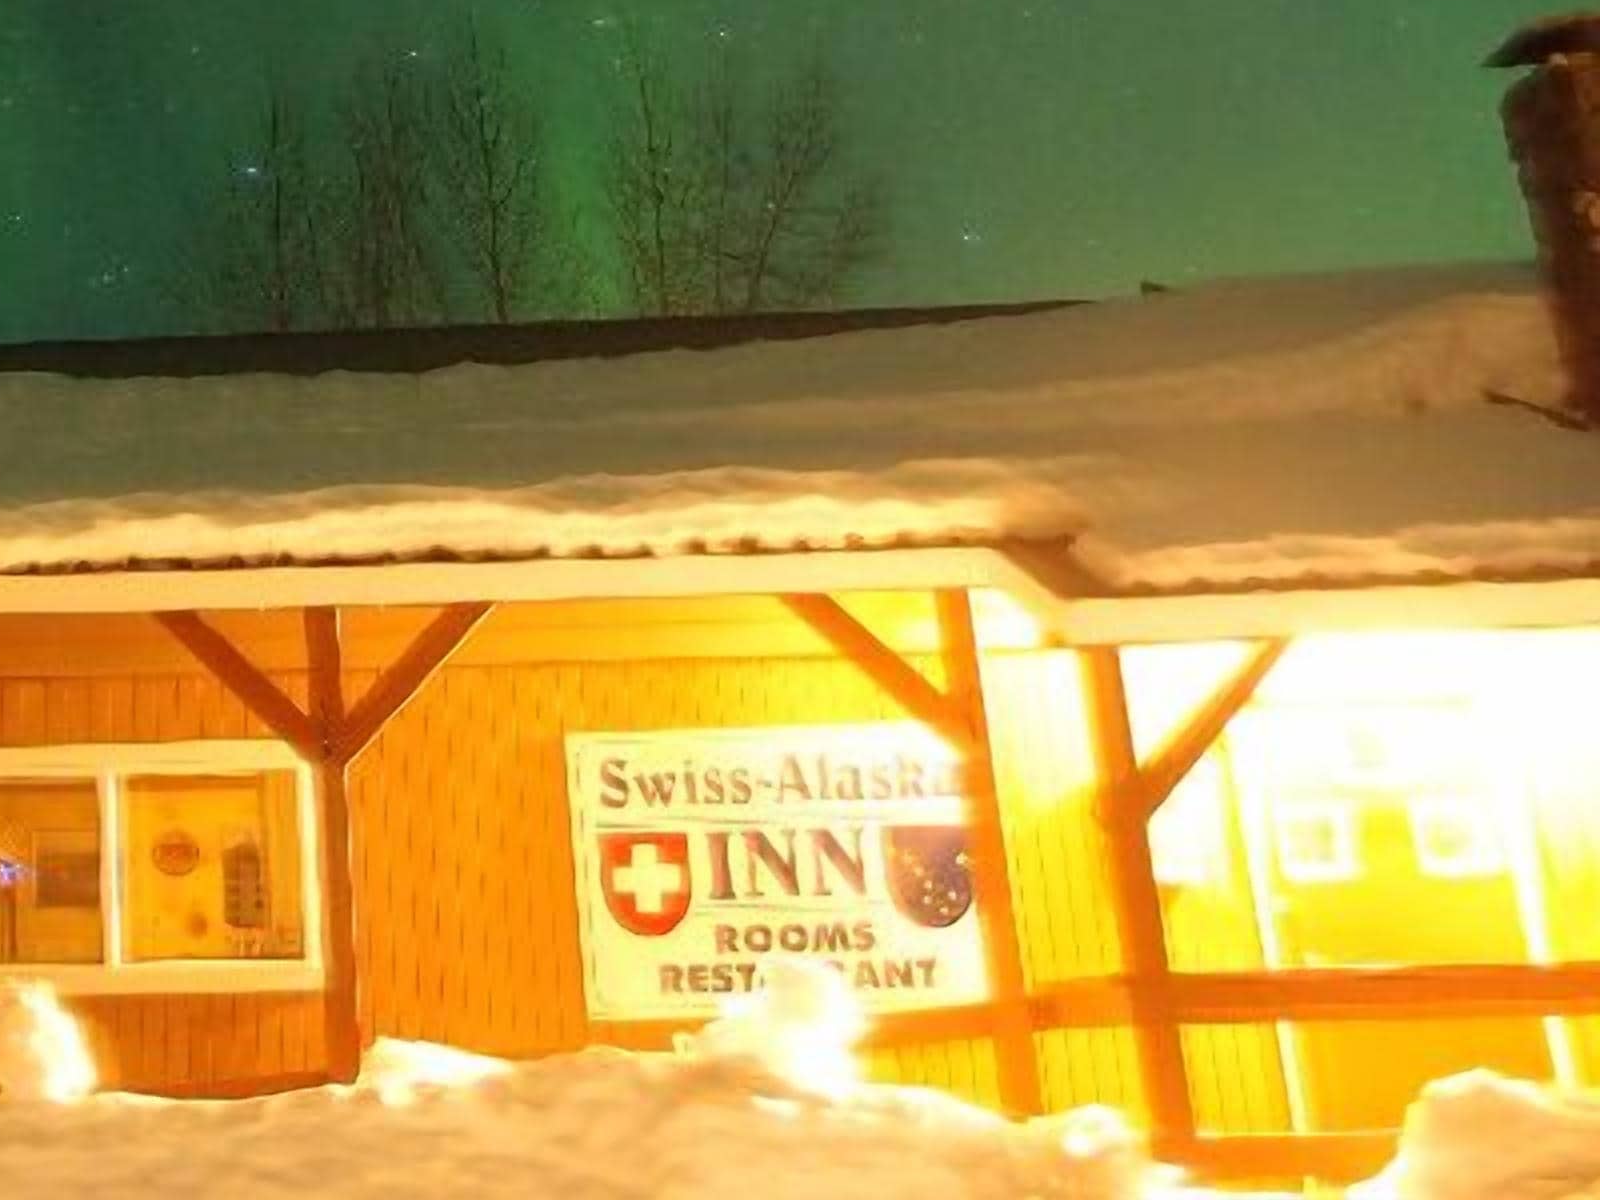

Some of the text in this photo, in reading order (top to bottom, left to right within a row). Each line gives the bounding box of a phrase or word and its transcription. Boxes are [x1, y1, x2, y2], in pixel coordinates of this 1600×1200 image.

[704, 828, 866, 900] INN
[714, 921, 875, 954] ROOMS
[659, 957, 937, 993] RESTANT
